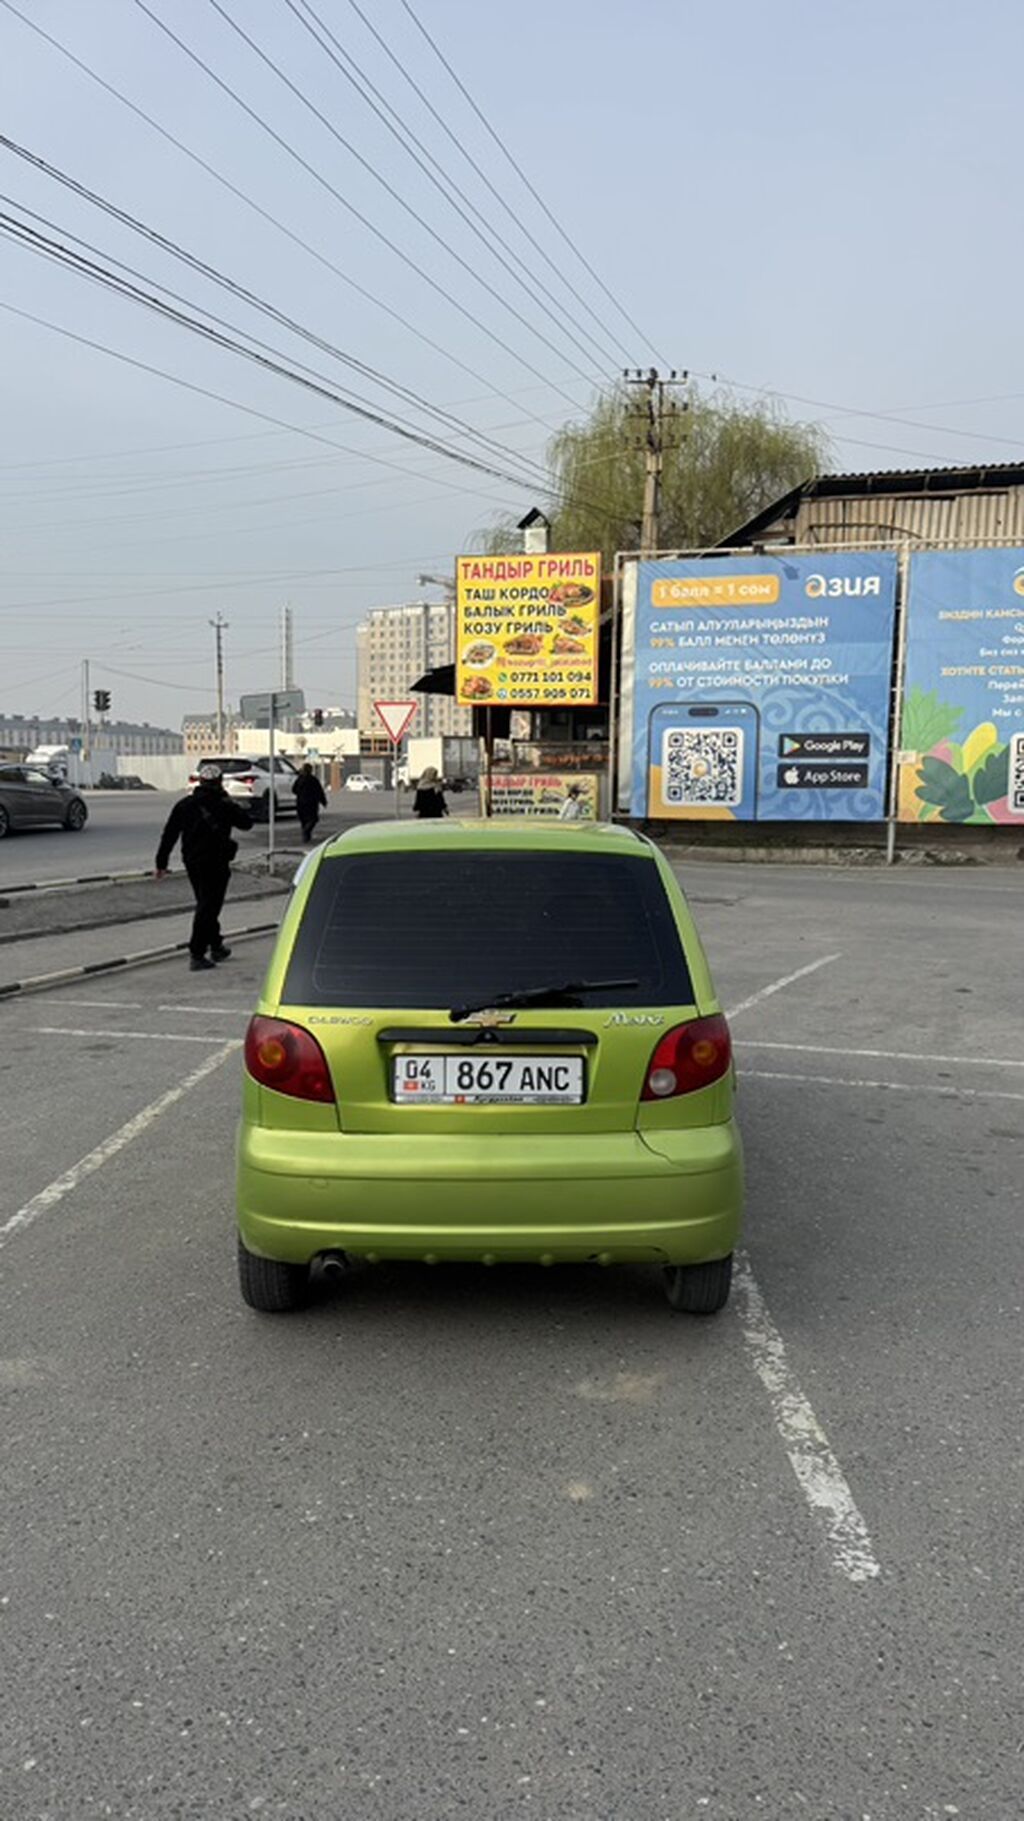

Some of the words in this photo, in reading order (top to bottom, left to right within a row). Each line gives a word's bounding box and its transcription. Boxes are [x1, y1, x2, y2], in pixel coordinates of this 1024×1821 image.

[462, 561, 533, 581] ТАНДЫР
[538, 559, 594, 577] ГРИЛЬ
[465, 588, 495, 600] ТАШ
[500, 586, 549, 600] КОРДО
[670, 583, 709, 598] балл
[738, 584, 771, 595] сом
[464, 605, 515, 618] БАЛЫК
[518, 604, 566, 617] ГРИЛЬ
[464, 622, 502, 635] КОЗУ
[506, 622, 553, 634] ГРИЛЬ
[649, 621, 694, 632] САТЫП
[678, 635, 711, 647] БАЛЛ
[715, 634, 759, 646] МЕНЕН
[649, 659, 740, 673] ОПЛАЧИВАЙТЕ
[744, 659, 807, 671] БАЛЛАМИ
[810, 658, 832, 671] ДО
[510, 672, 539, 682] 0771
[542, 672, 563, 682] 101
[567, 672, 592, 682] 094
[676, 676, 694, 687] ОТ
[697, 674, 780, 687] СТОИМОСТИ
[783, 674, 848, 686] ПОКУПКИ
[510, 688, 540, 698] 0557
[570, 688, 591, 698] 071
[804, 740, 841, 753] Google
[843, 740, 865, 752] Play
[804, 771, 829, 784] App
[830, 770, 861, 782] Store
[406, 1060, 431, 1079] 04
[457, 1061, 513, 1091] 867
[520, 1067, 570, 1091] ANC
[421, 1081, 436, 1092] KG
